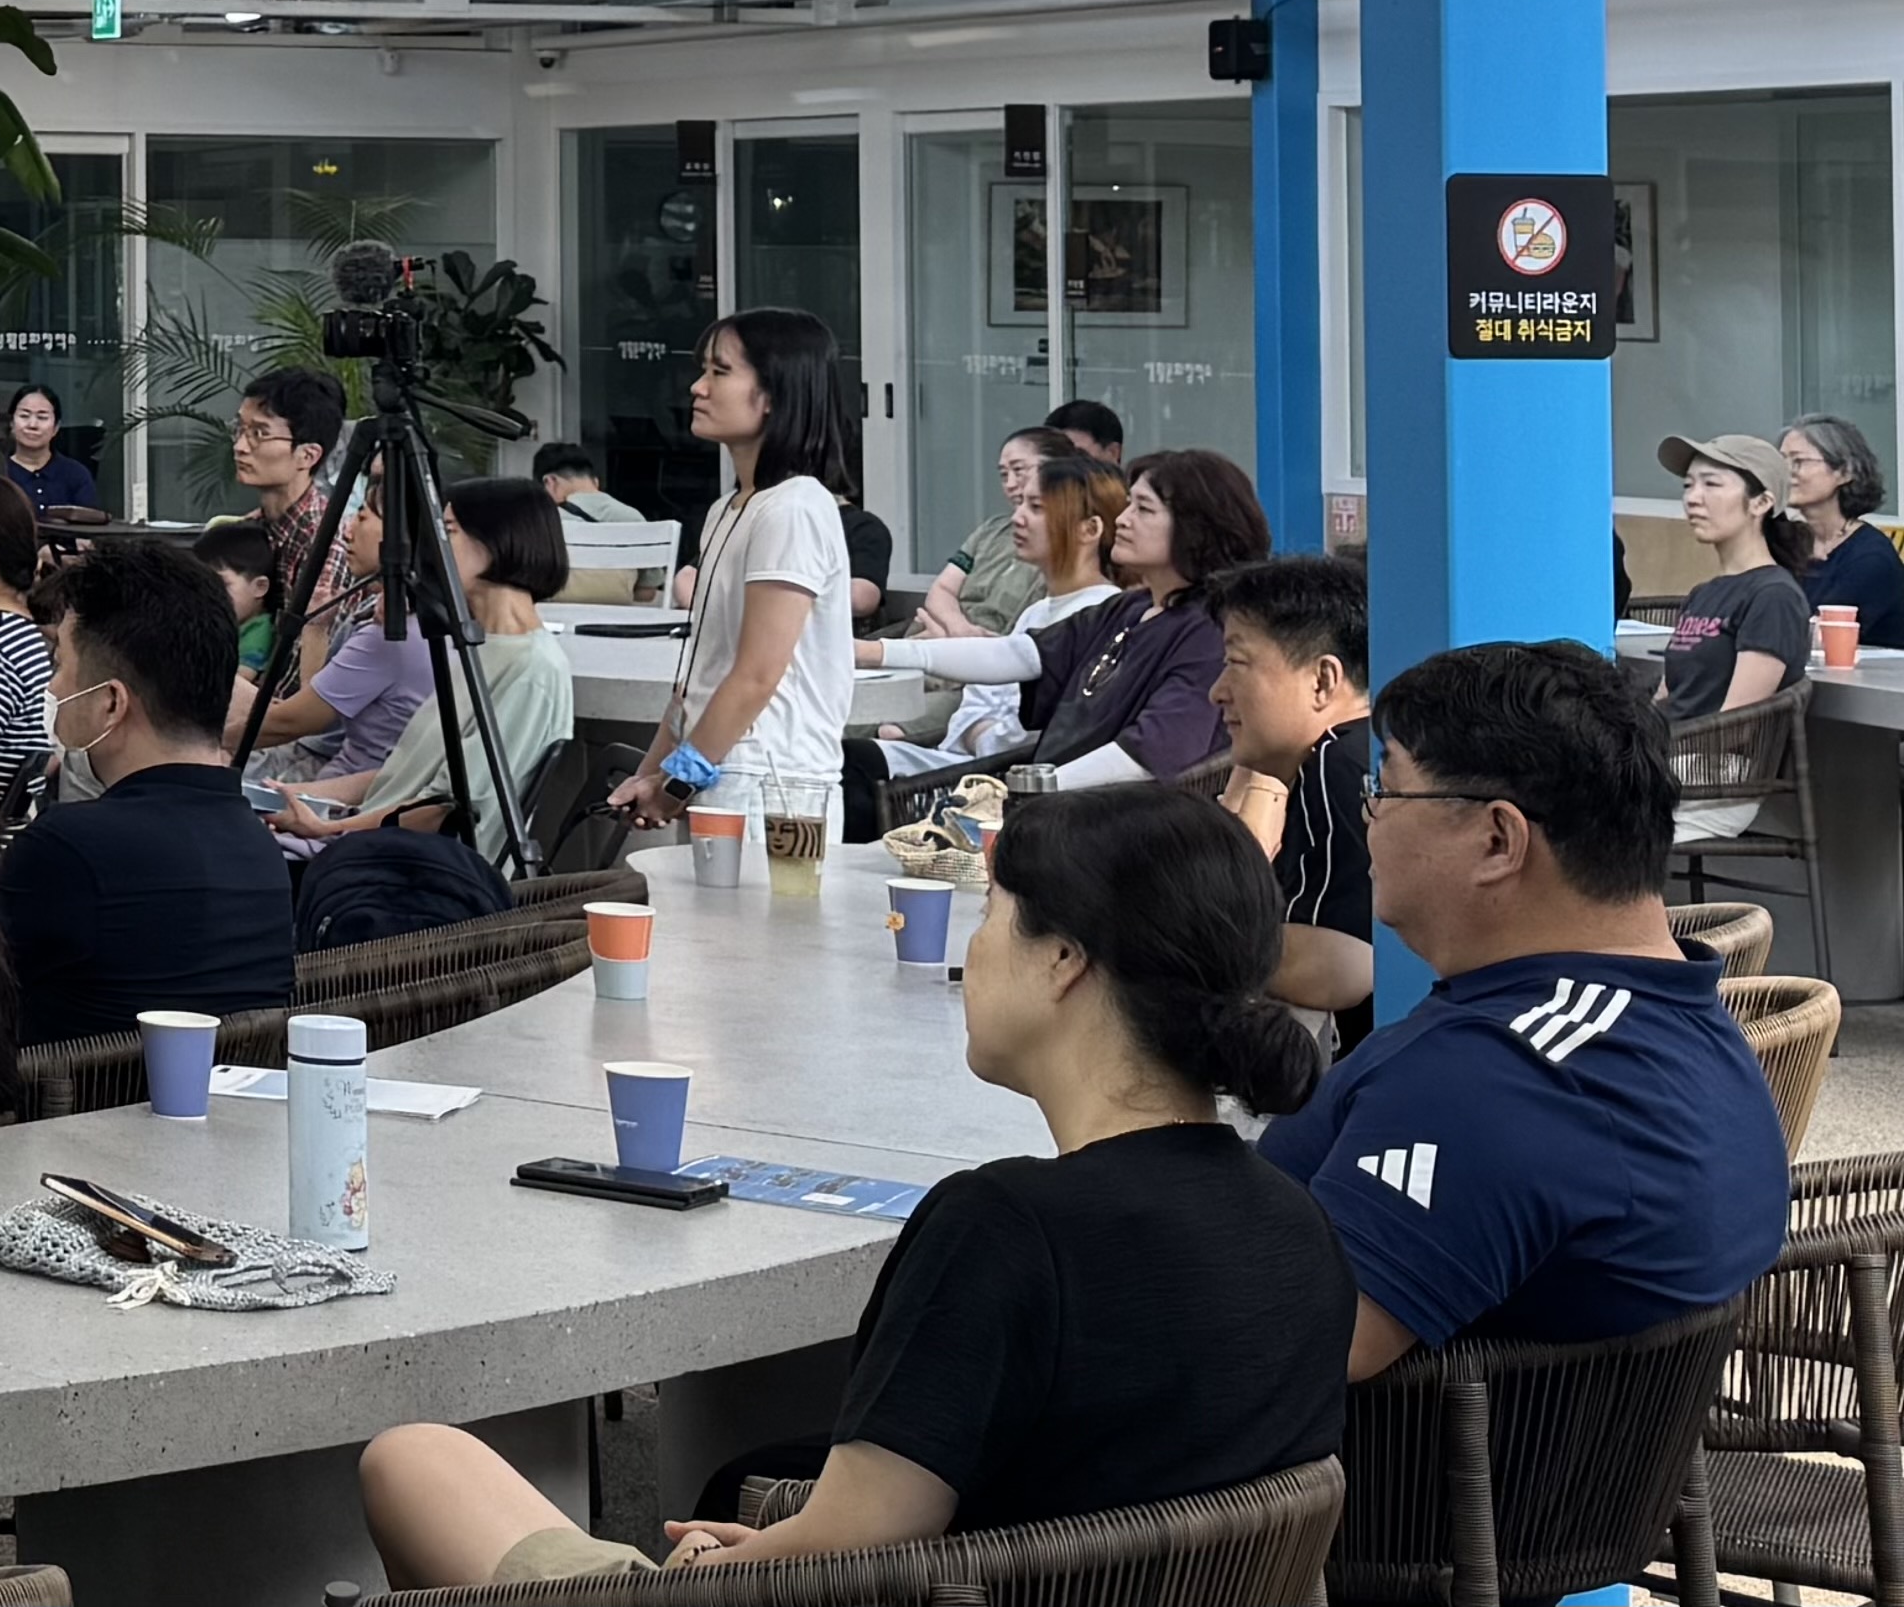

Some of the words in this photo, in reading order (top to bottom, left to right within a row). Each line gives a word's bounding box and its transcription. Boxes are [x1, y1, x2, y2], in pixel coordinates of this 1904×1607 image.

[1468, 290, 1597, 315] 커뮤니티라운지
[1475, 318, 1512, 342] 절대
[1517, 318, 1592, 343] 취식금지
